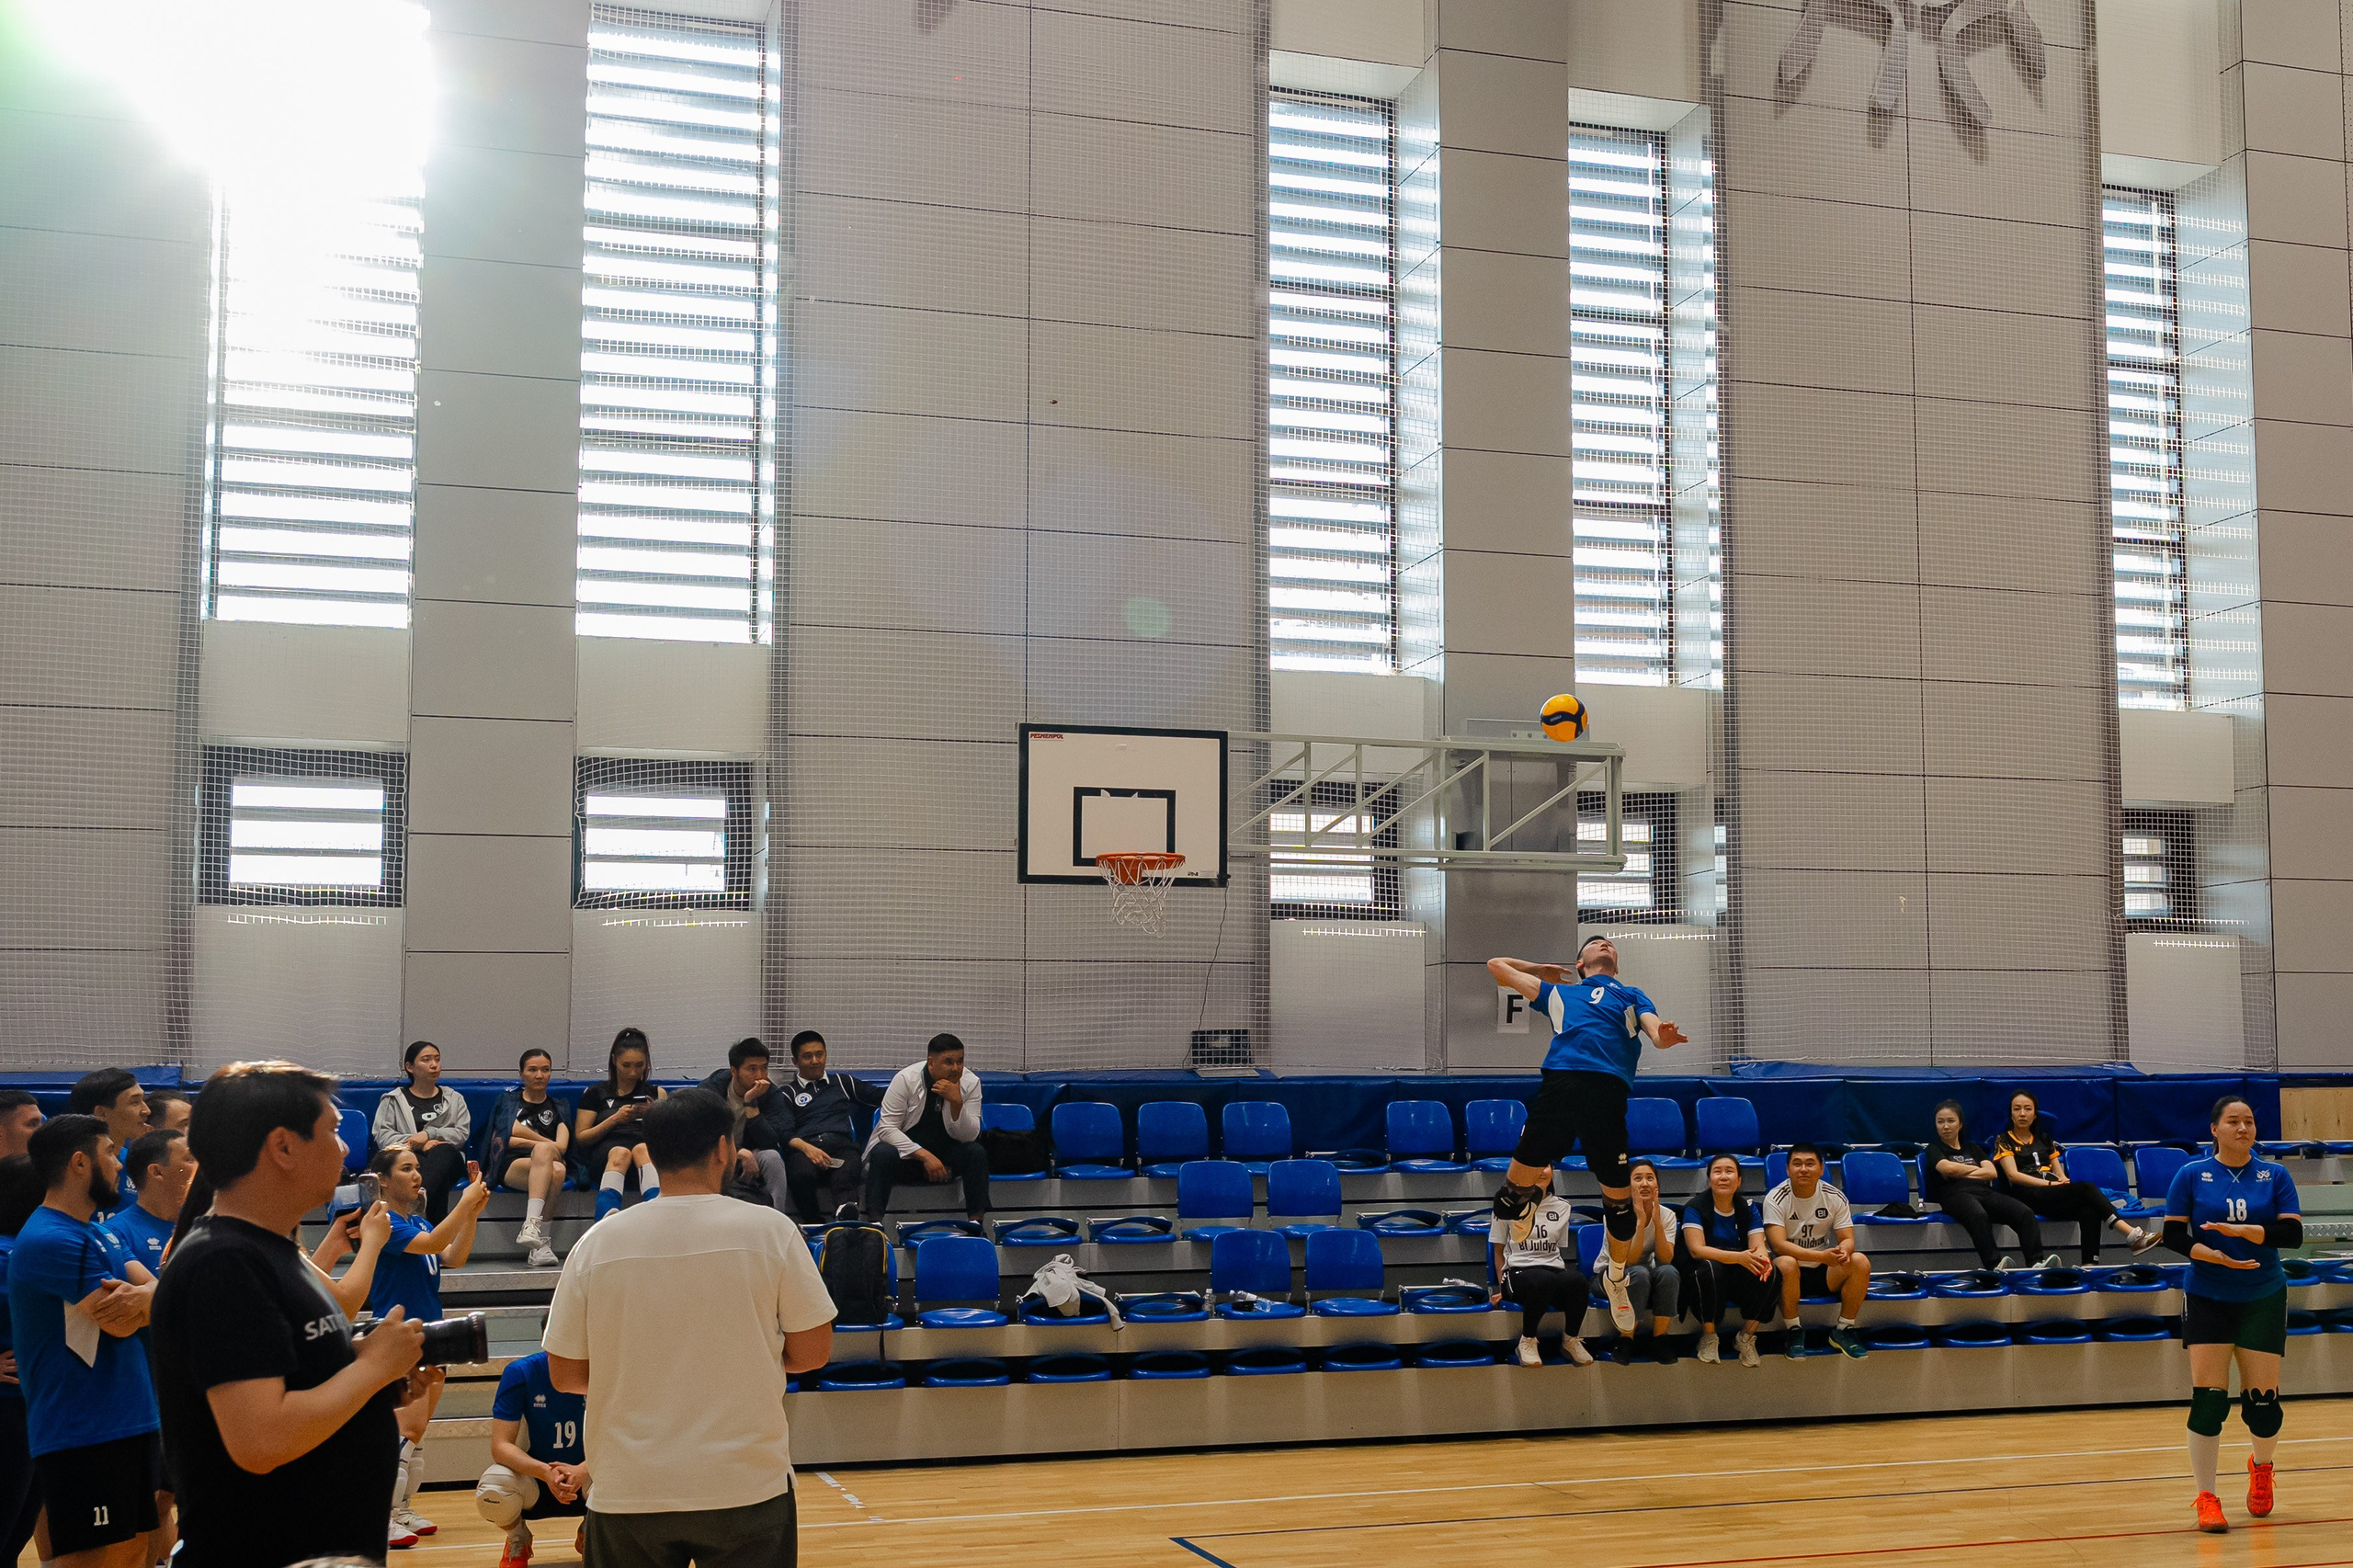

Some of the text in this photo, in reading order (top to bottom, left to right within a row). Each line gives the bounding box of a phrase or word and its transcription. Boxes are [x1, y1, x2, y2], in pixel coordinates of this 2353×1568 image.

[1589, 986, 1605, 1005] 9
[1506, 994, 1523, 1024] F
[2031, 1151, 2040, 1166] 1
[2226, 1198, 2247, 1221] 18
[1535, 1225, 1548, 1239] 16
[1802, 1225, 1813, 1238] 97
[552, 1420, 576, 1449] 19
[94, 1506, 109, 1526] 11
